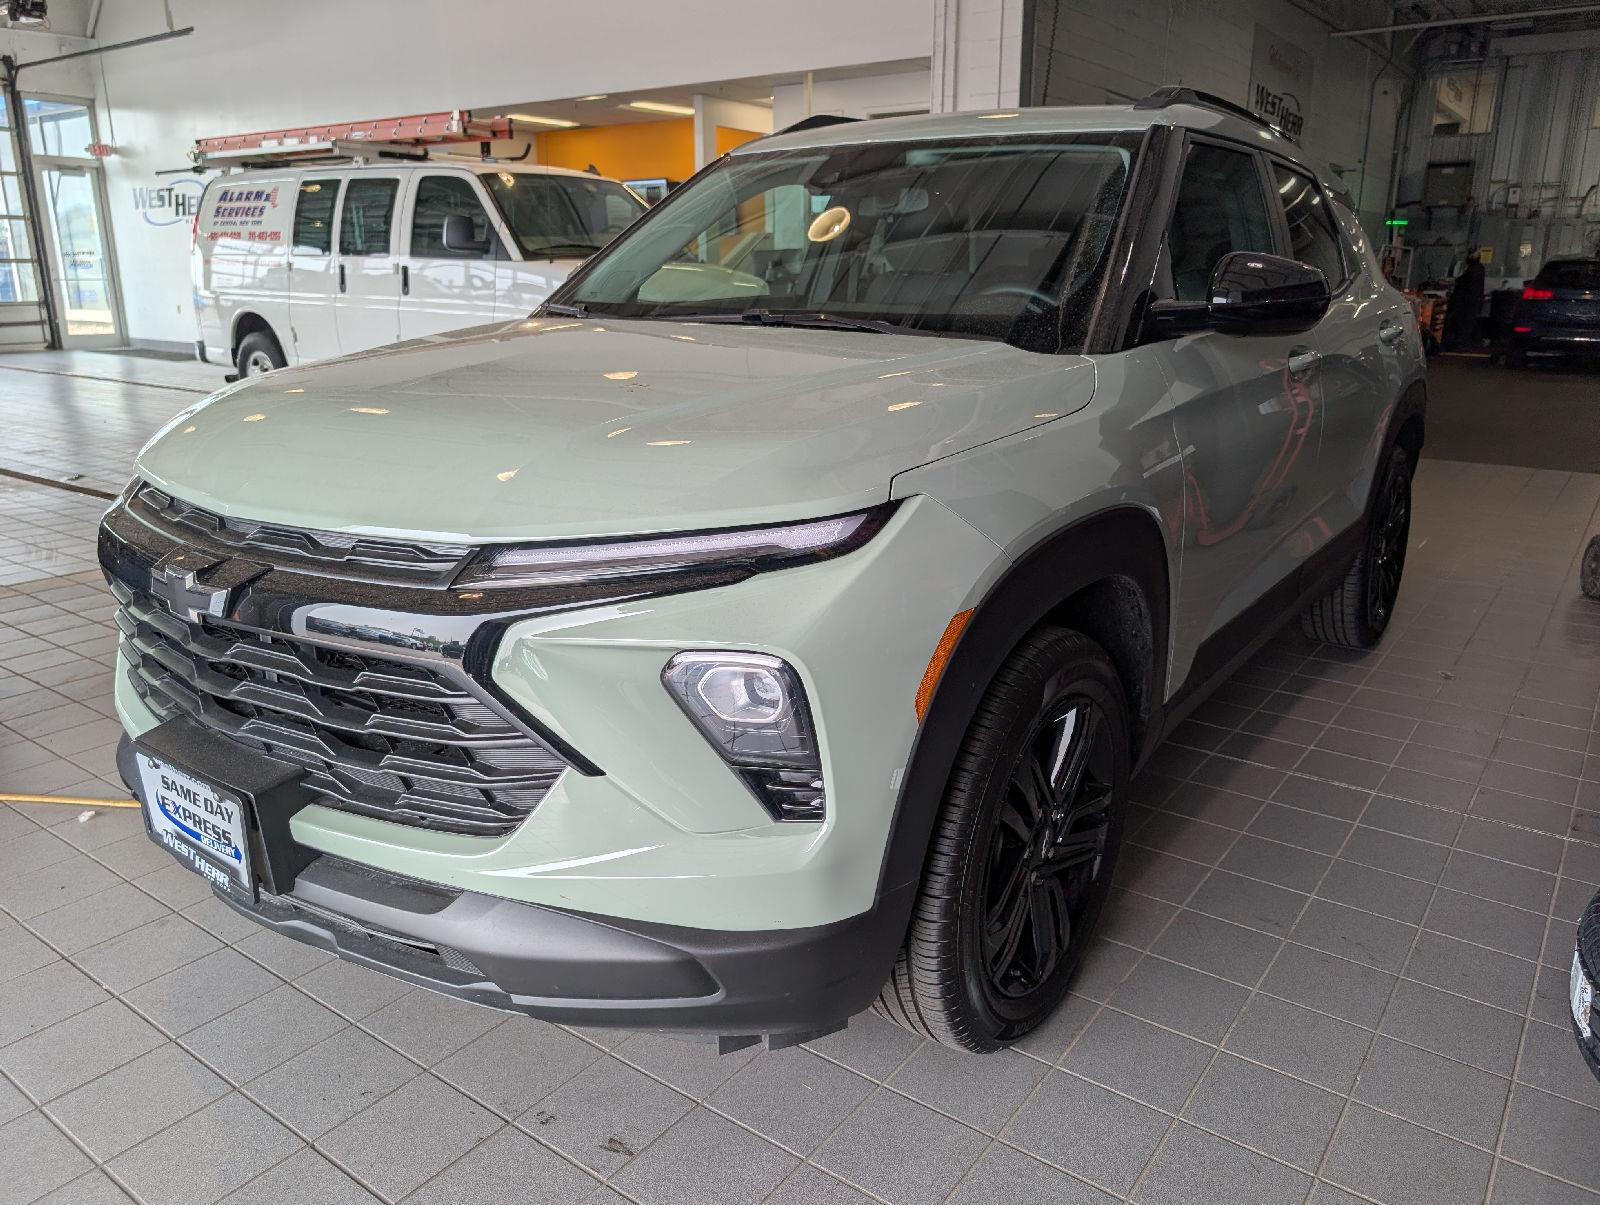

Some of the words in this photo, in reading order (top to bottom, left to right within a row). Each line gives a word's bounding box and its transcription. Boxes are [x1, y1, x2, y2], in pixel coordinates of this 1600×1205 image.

[1255, 83, 1283, 117] WEST
[133, 187, 174, 211] WEST
[213, 205, 267, 219] SERVICES
[160, 774, 202, 809] SAME
[203, 800, 234, 826] DAY
[160, 795, 233, 846] EXPRESS
[162, 828, 198, 861] WEST
[194, 855, 231, 887] HERR
[200, 835, 237, 858] DELIVERY
